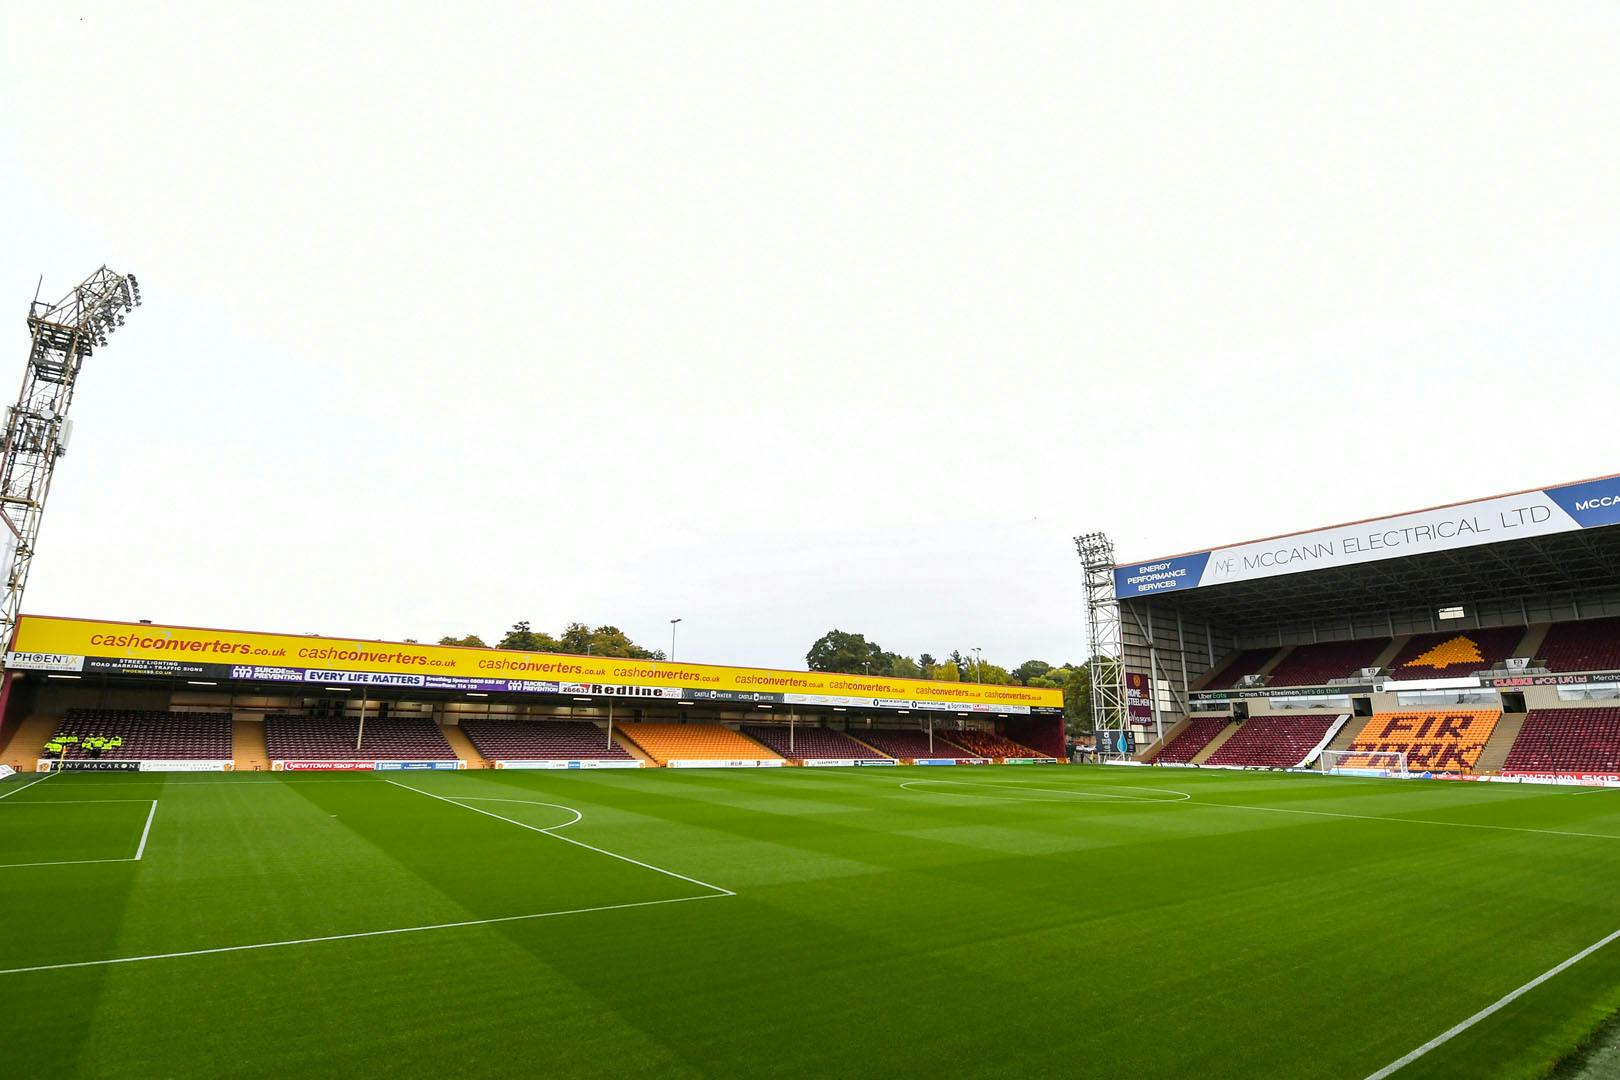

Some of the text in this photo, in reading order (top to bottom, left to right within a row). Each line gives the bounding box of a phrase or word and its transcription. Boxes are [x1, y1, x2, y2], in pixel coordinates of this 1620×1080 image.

[1243, 504, 1551, 570] MCCANN ELECTRICAL LTD
[1139, 562, 1171, 574] ENERGY
[1127, 569, 1186, 584] PERFORMANCE
[1138, 580, 1176, 592] SERVICES
[90, 634, 286, 657] cashconverters.co.uk
[298, 647, 456, 667] cashconverters.co.uk
[478, 658, 606, 676] cashconverters.co.uk
[253, 673, 302, 681] PREVENTION
[309, 672, 420, 685] EVERY LIFE MATTERS
[613, 667, 721, 683] cashconverters.co.uk
[735, 675, 824, 688] cashconverters.co.uk
[1493, 677, 1534, 687] CLARKE
[591, 684, 663, 696] Redline
[1127, 688, 1141, 698] HOME
[1127, 697, 1150, 706] STEELMEN
[1379, 715, 1474, 738] FIR
[1336, 742, 1485, 769] PARK
[1581, 774, 1620, 784] SKIP
